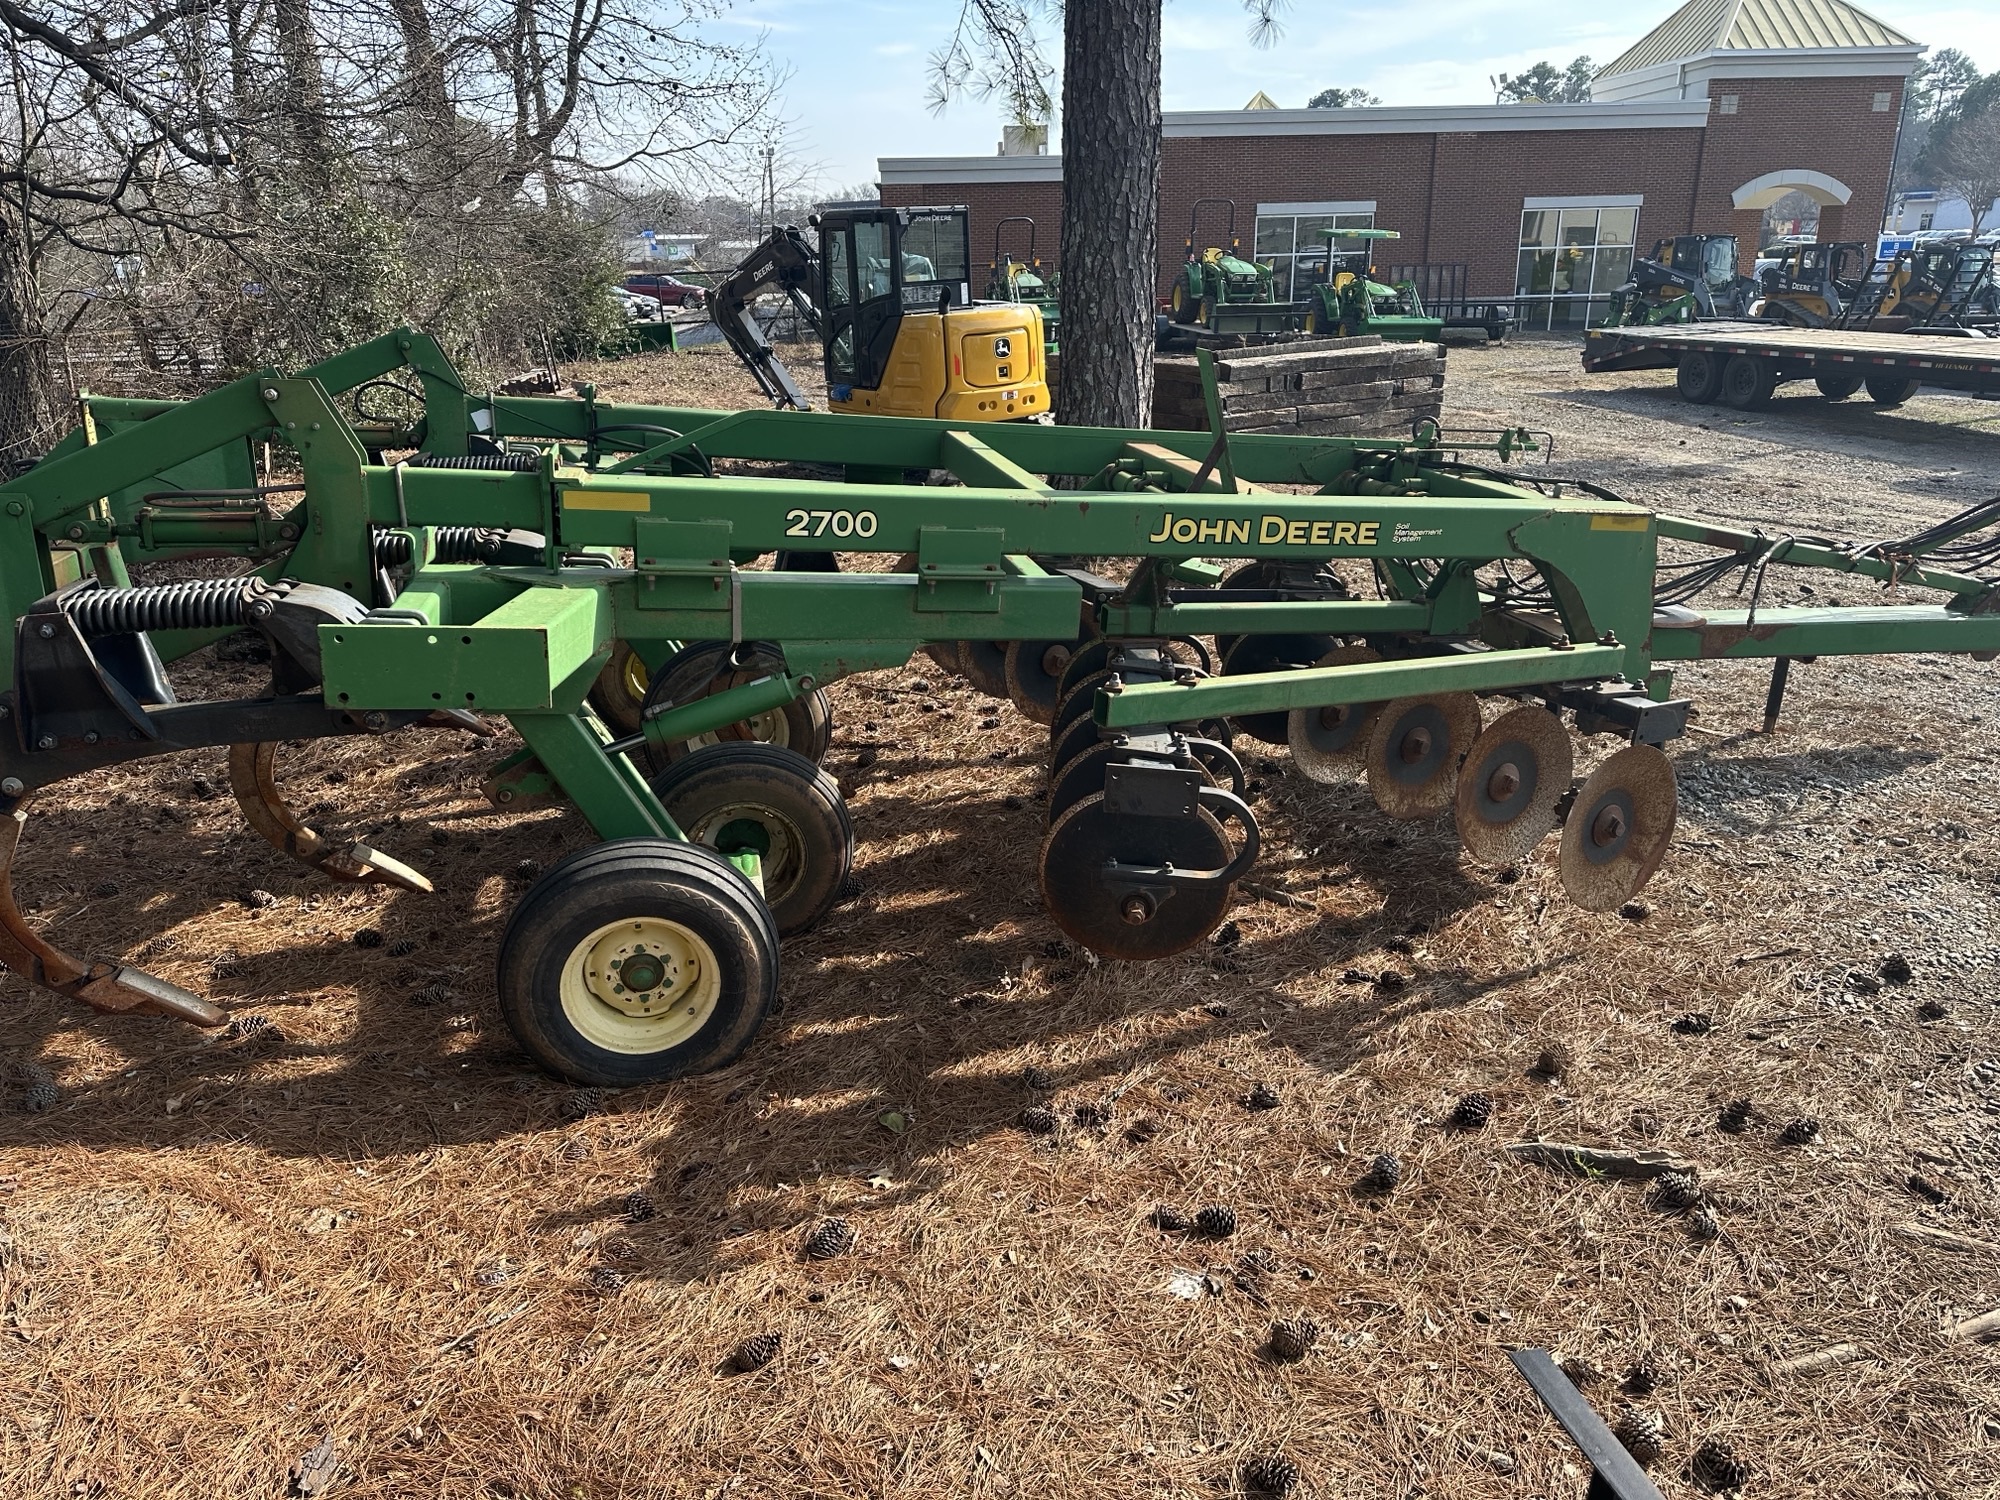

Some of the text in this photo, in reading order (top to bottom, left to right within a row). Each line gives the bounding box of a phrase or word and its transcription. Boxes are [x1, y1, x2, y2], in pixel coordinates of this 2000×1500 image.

[753, 260, 775, 282] DEERE
[1791, 282, 1811, 291] DEERE
[785, 508, 878, 538] 2700
[1395, 522, 1411, 530] Soil
[1150, 512, 1381, 546] JOHN DEERE
[1394, 528, 1443, 537] Management
[1392, 535, 1422, 544] System
